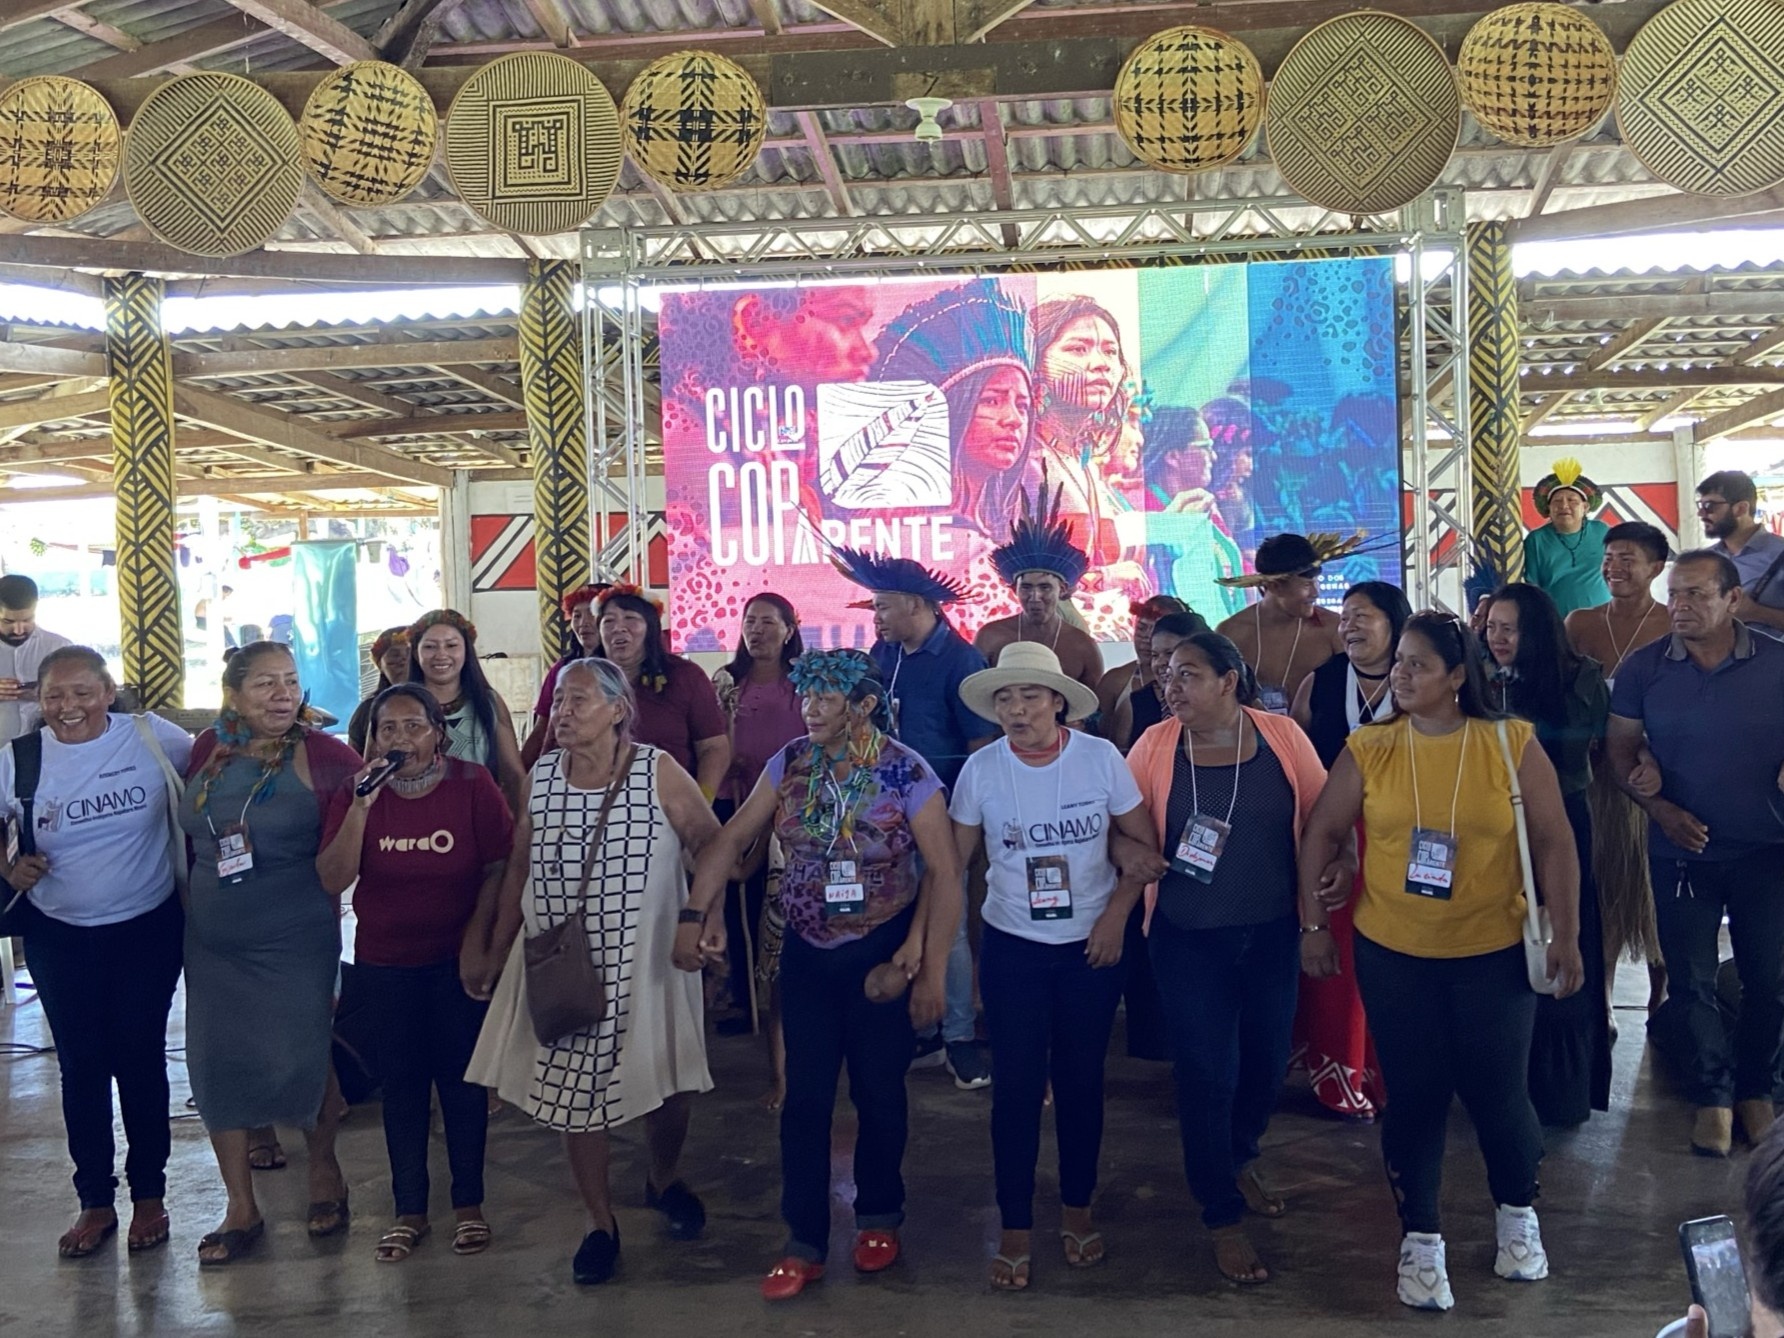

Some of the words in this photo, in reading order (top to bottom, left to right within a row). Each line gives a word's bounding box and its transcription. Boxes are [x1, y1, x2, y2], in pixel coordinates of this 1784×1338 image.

[705, 384, 805, 453] CICLO
[66, 786, 146, 819] CINAMO
[1029, 813, 1102, 843] CINAMO
